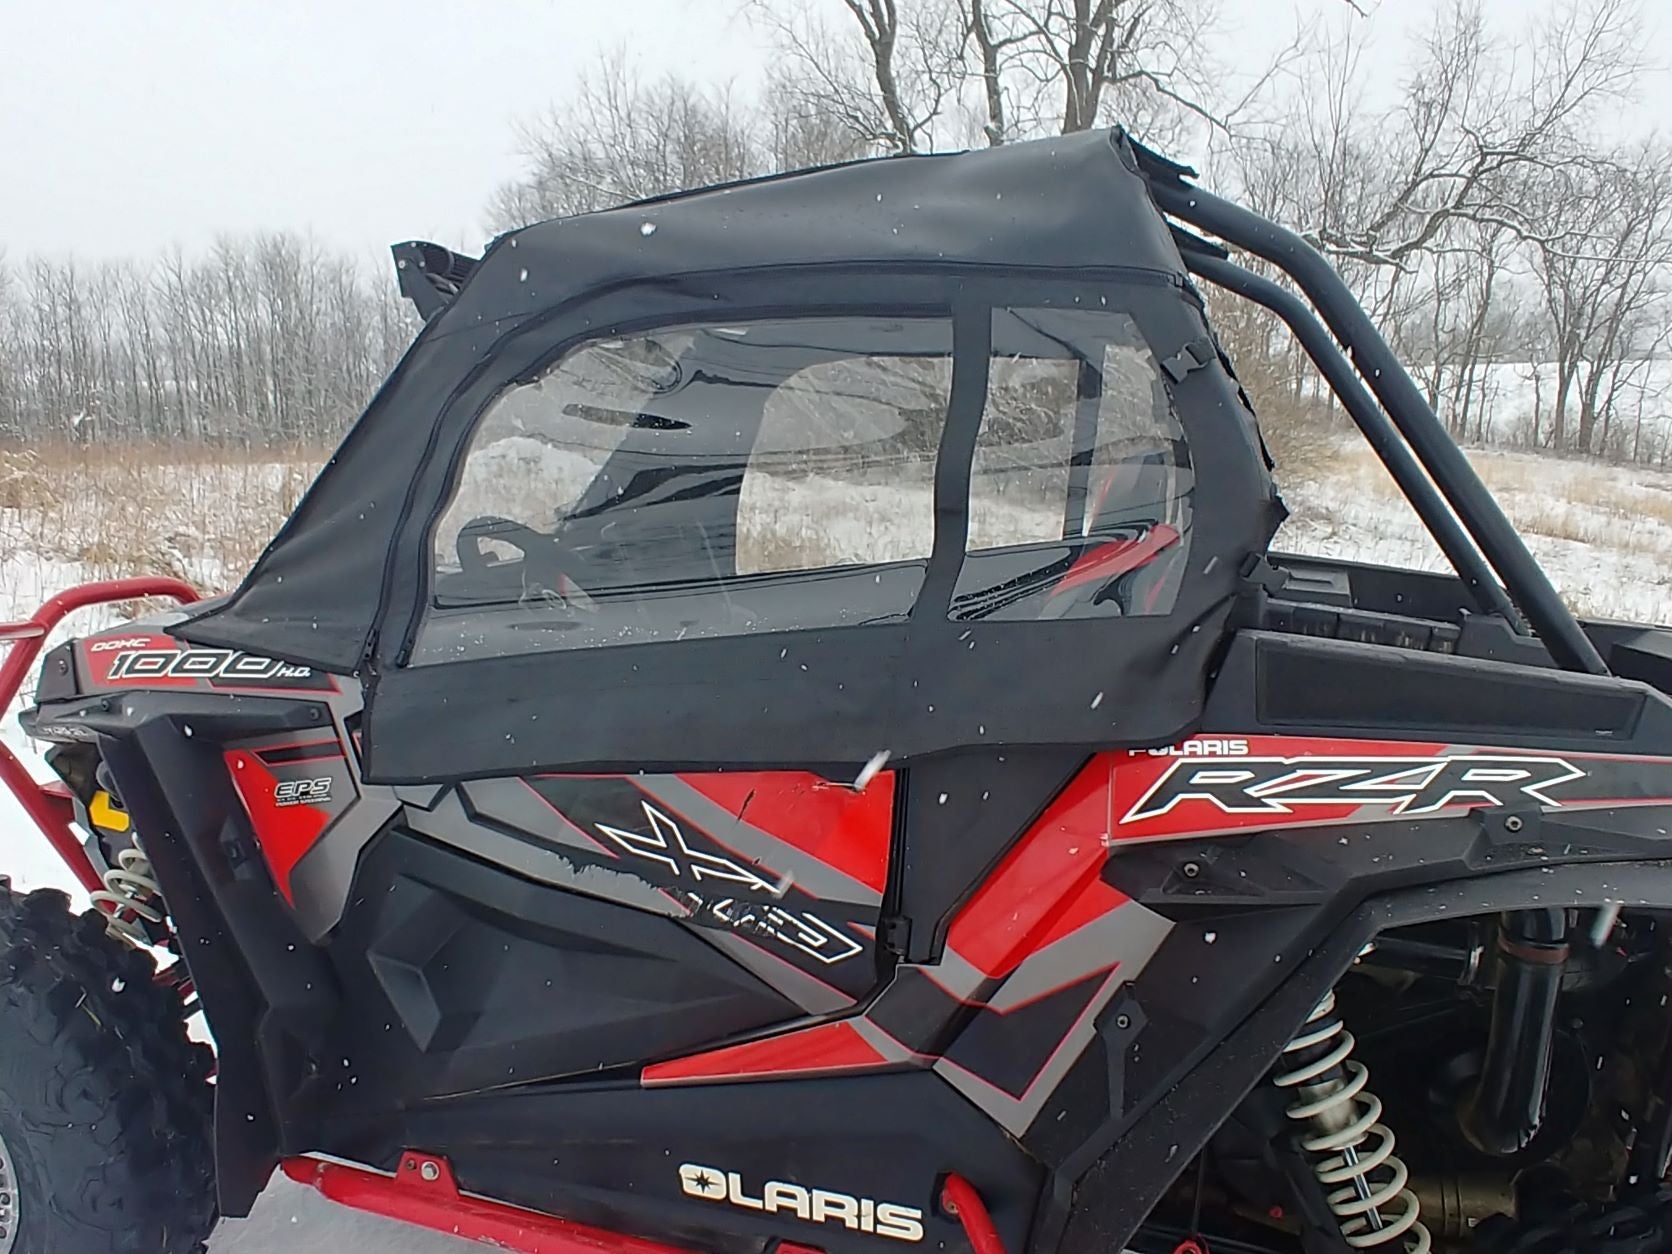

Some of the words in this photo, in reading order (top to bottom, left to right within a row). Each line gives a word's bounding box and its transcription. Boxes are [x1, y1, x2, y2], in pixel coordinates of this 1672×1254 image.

[90, 637, 152, 652] DOHC
[106, 649, 284, 681] 1000
[273, 776, 333, 799] EPS
[1119, 754, 1588, 824] RZR
